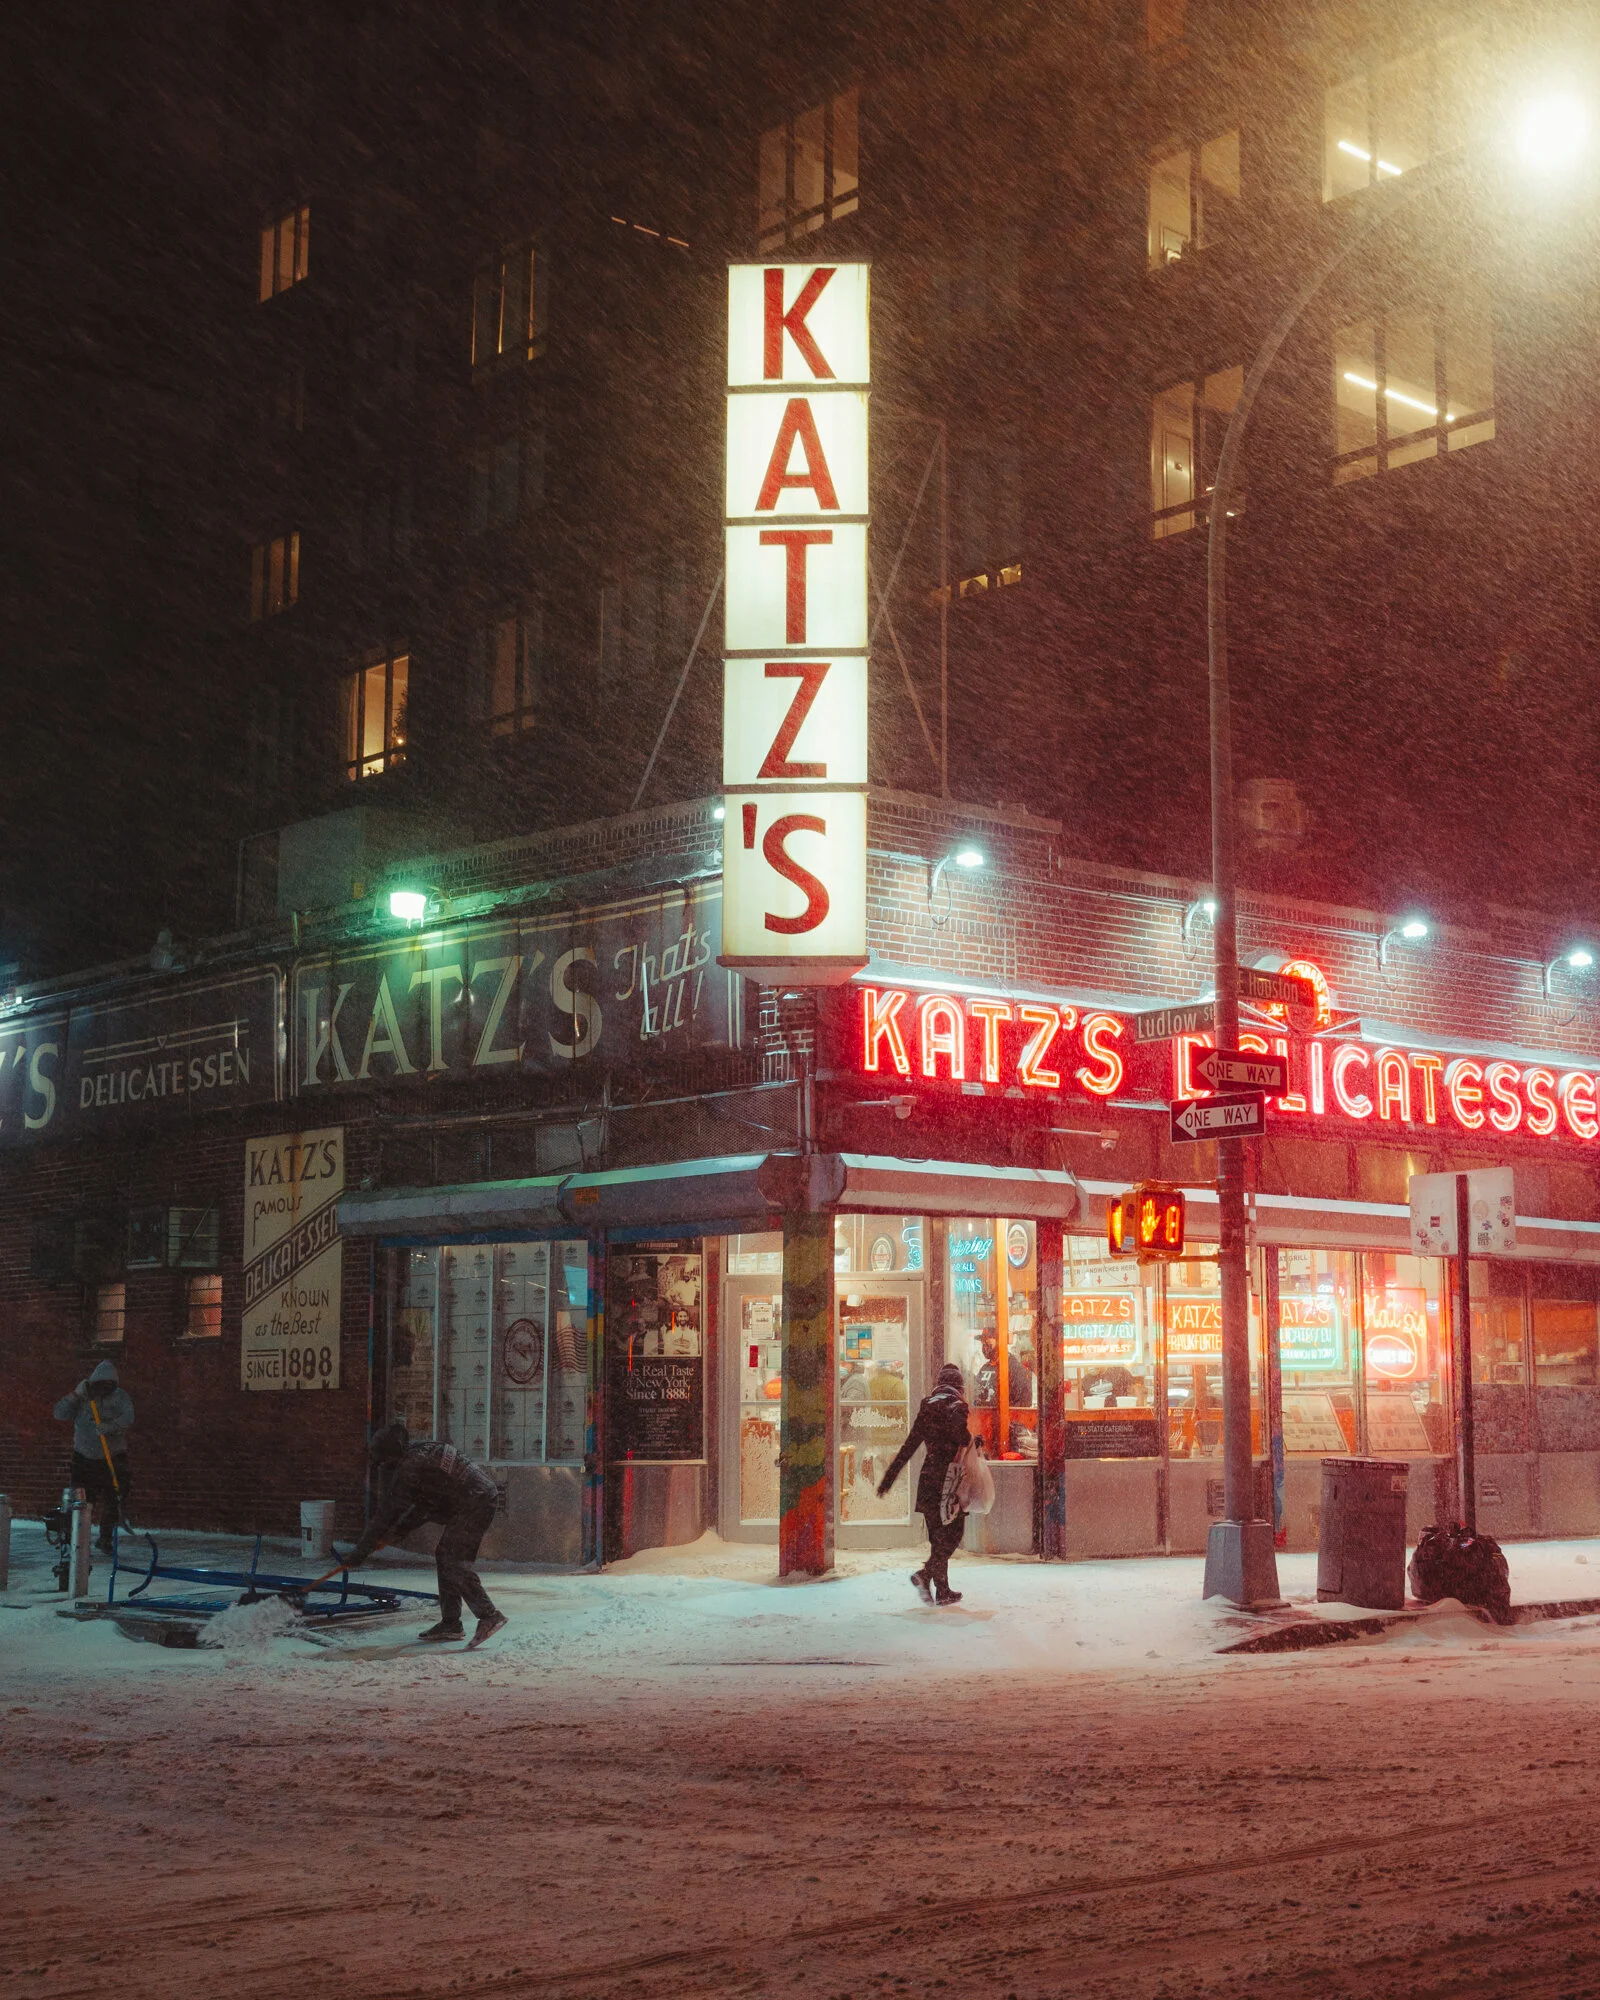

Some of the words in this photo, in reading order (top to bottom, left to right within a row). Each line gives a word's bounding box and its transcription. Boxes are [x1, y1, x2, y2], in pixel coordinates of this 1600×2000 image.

[742, 268, 841, 936] KATZ'S
[614, 923, 711, 1000] That's
[1249, 972, 1299, 1003] Houston
[302, 947, 604, 1086] KATZ'S
[1137, 1013, 1197, 1039] Ludlow
[1203, 1006, 1215, 1022] St
[863, 988, 1125, 1097] KATZ'S
[0, 1043, 59, 1130] 'S
[80, 1048, 248, 1109] DELICATESSEN
[1176, 1034, 1600, 1140] DLICATESSE
[1206, 1061, 1233, 1080] ONE
[1246, 1066, 1275, 1082] WAY
[1185, 1107, 1212, 1129] ONE
[1223, 1104, 1252, 1124] WAY
[250, 1140, 338, 1187] KATZ'S
[245, 1203, 340, 1306] DELICATESSEN
[281, 1289, 330, 1309] KNOWN
[255, 1323, 268, 1337] as
[270, 1312, 290, 1337] the
[289, 1311, 322, 1336] Best
[1172, 1302, 1222, 1329] KATZ'S
[1167, 1333, 1222, 1351] FRANKFURTE
[246, 1360, 281, 1379] SINCE
[635, 1377, 660, 1388] New
[664, 1376, 689, 1388] York
[642, 1364, 667, 1377] Real
[669, 1364, 695, 1377] Taste
[626, 1387, 658, 1400] Since
